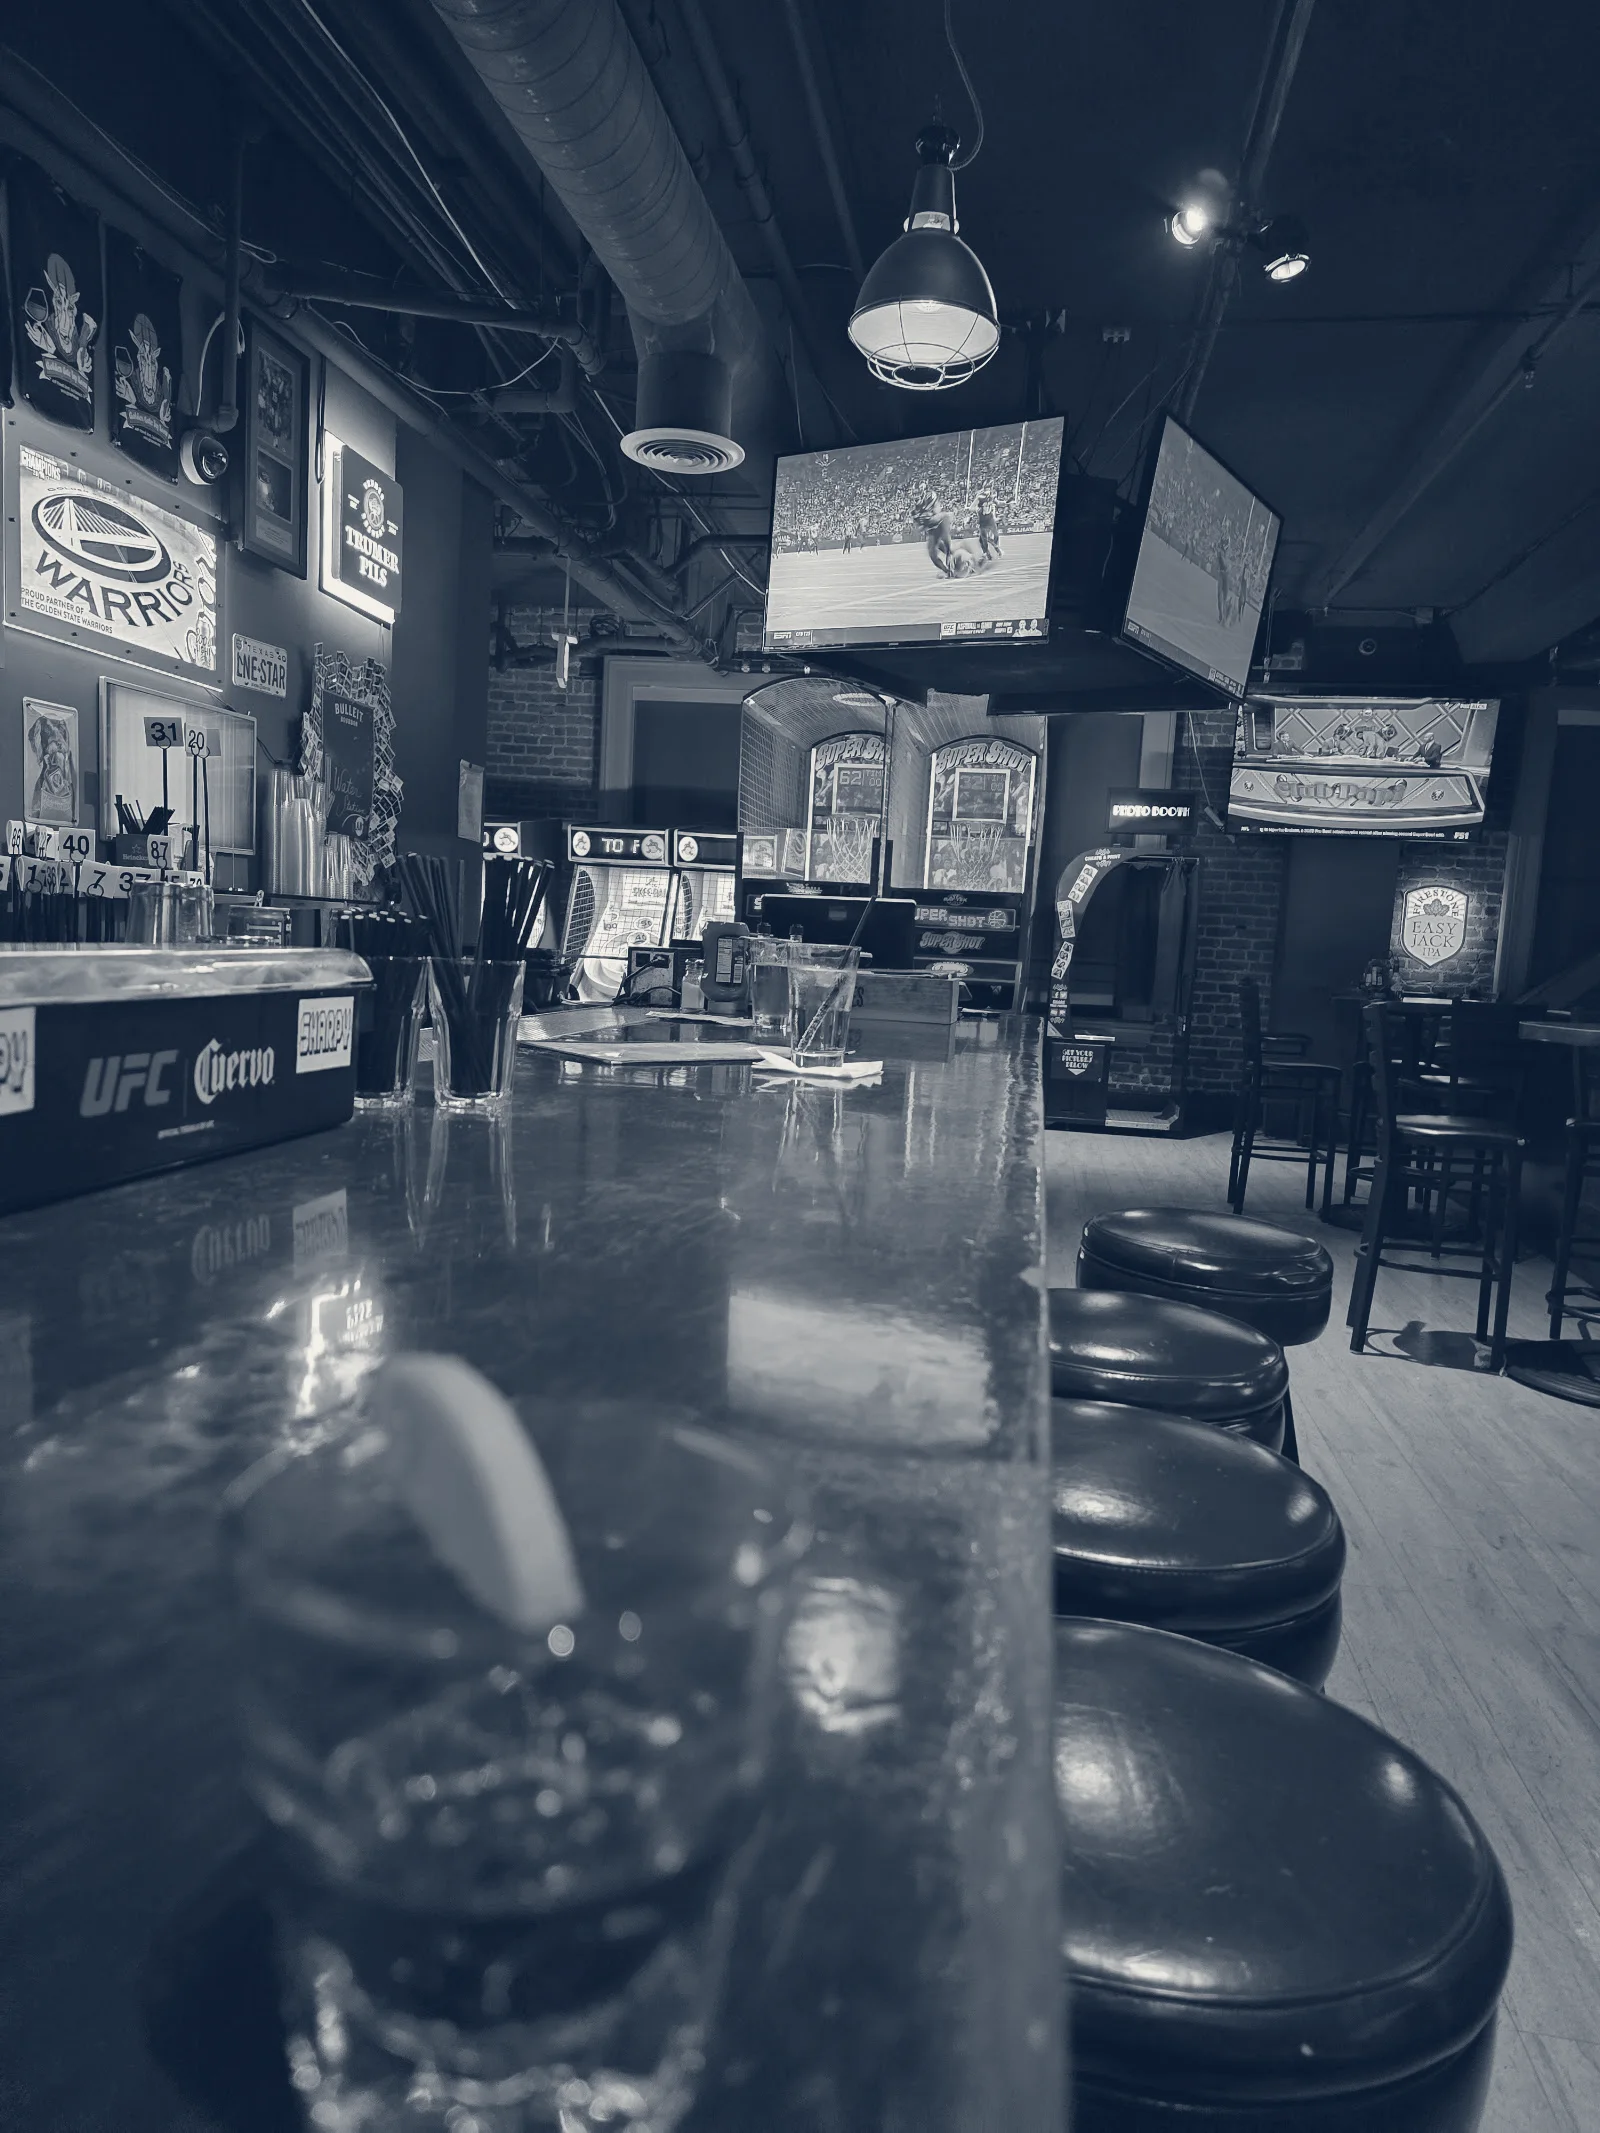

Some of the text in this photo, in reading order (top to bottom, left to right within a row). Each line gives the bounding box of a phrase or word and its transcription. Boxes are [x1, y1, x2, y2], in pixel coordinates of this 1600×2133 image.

[20, 450, 61, 481] CHAMPIONS
[345, 524, 400, 575] TRUMER
[359, 554, 387, 588] PILS
[35, 549, 194, 627] WARRIORS
[21, 587, 84, 614] PROUD PARTNER OF
[21, 596, 113, 634] THE GOLDEN STATE WARRIORS
[773, 631, 792, 639] ESPN
[334, 703, 364, 722] BULLEIT
[151, 722, 177, 741] 31
[188, 729, 205, 750] 20
[815, 738, 866, 772] SUPER
[936, 741, 1033, 775] SUPER SHOT
[839, 770, 861, 786] 62
[1112, 804, 1190, 817] PHOTO BOOTH
[62, 834, 90, 856] 40
[150, 840, 169, 860] 87
[601, 837, 624, 853] TO
[122, 853, 149, 861] Heineke
[93, 869, 107, 888] 7
[1412, 889, 1459, 917] FIRESTONE
[946, 915, 986, 928] SHOT
[1412, 921, 1457, 935] EASY
[919, 931, 986, 950] SUPER SHOT
[1411, 933, 1456, 948] JACK
[1422, 947, 1441, 957] IPA
[300, 1008, 352, 1057] SHARPY
[79, 1037, 275, 1119] UFC Cuervo
